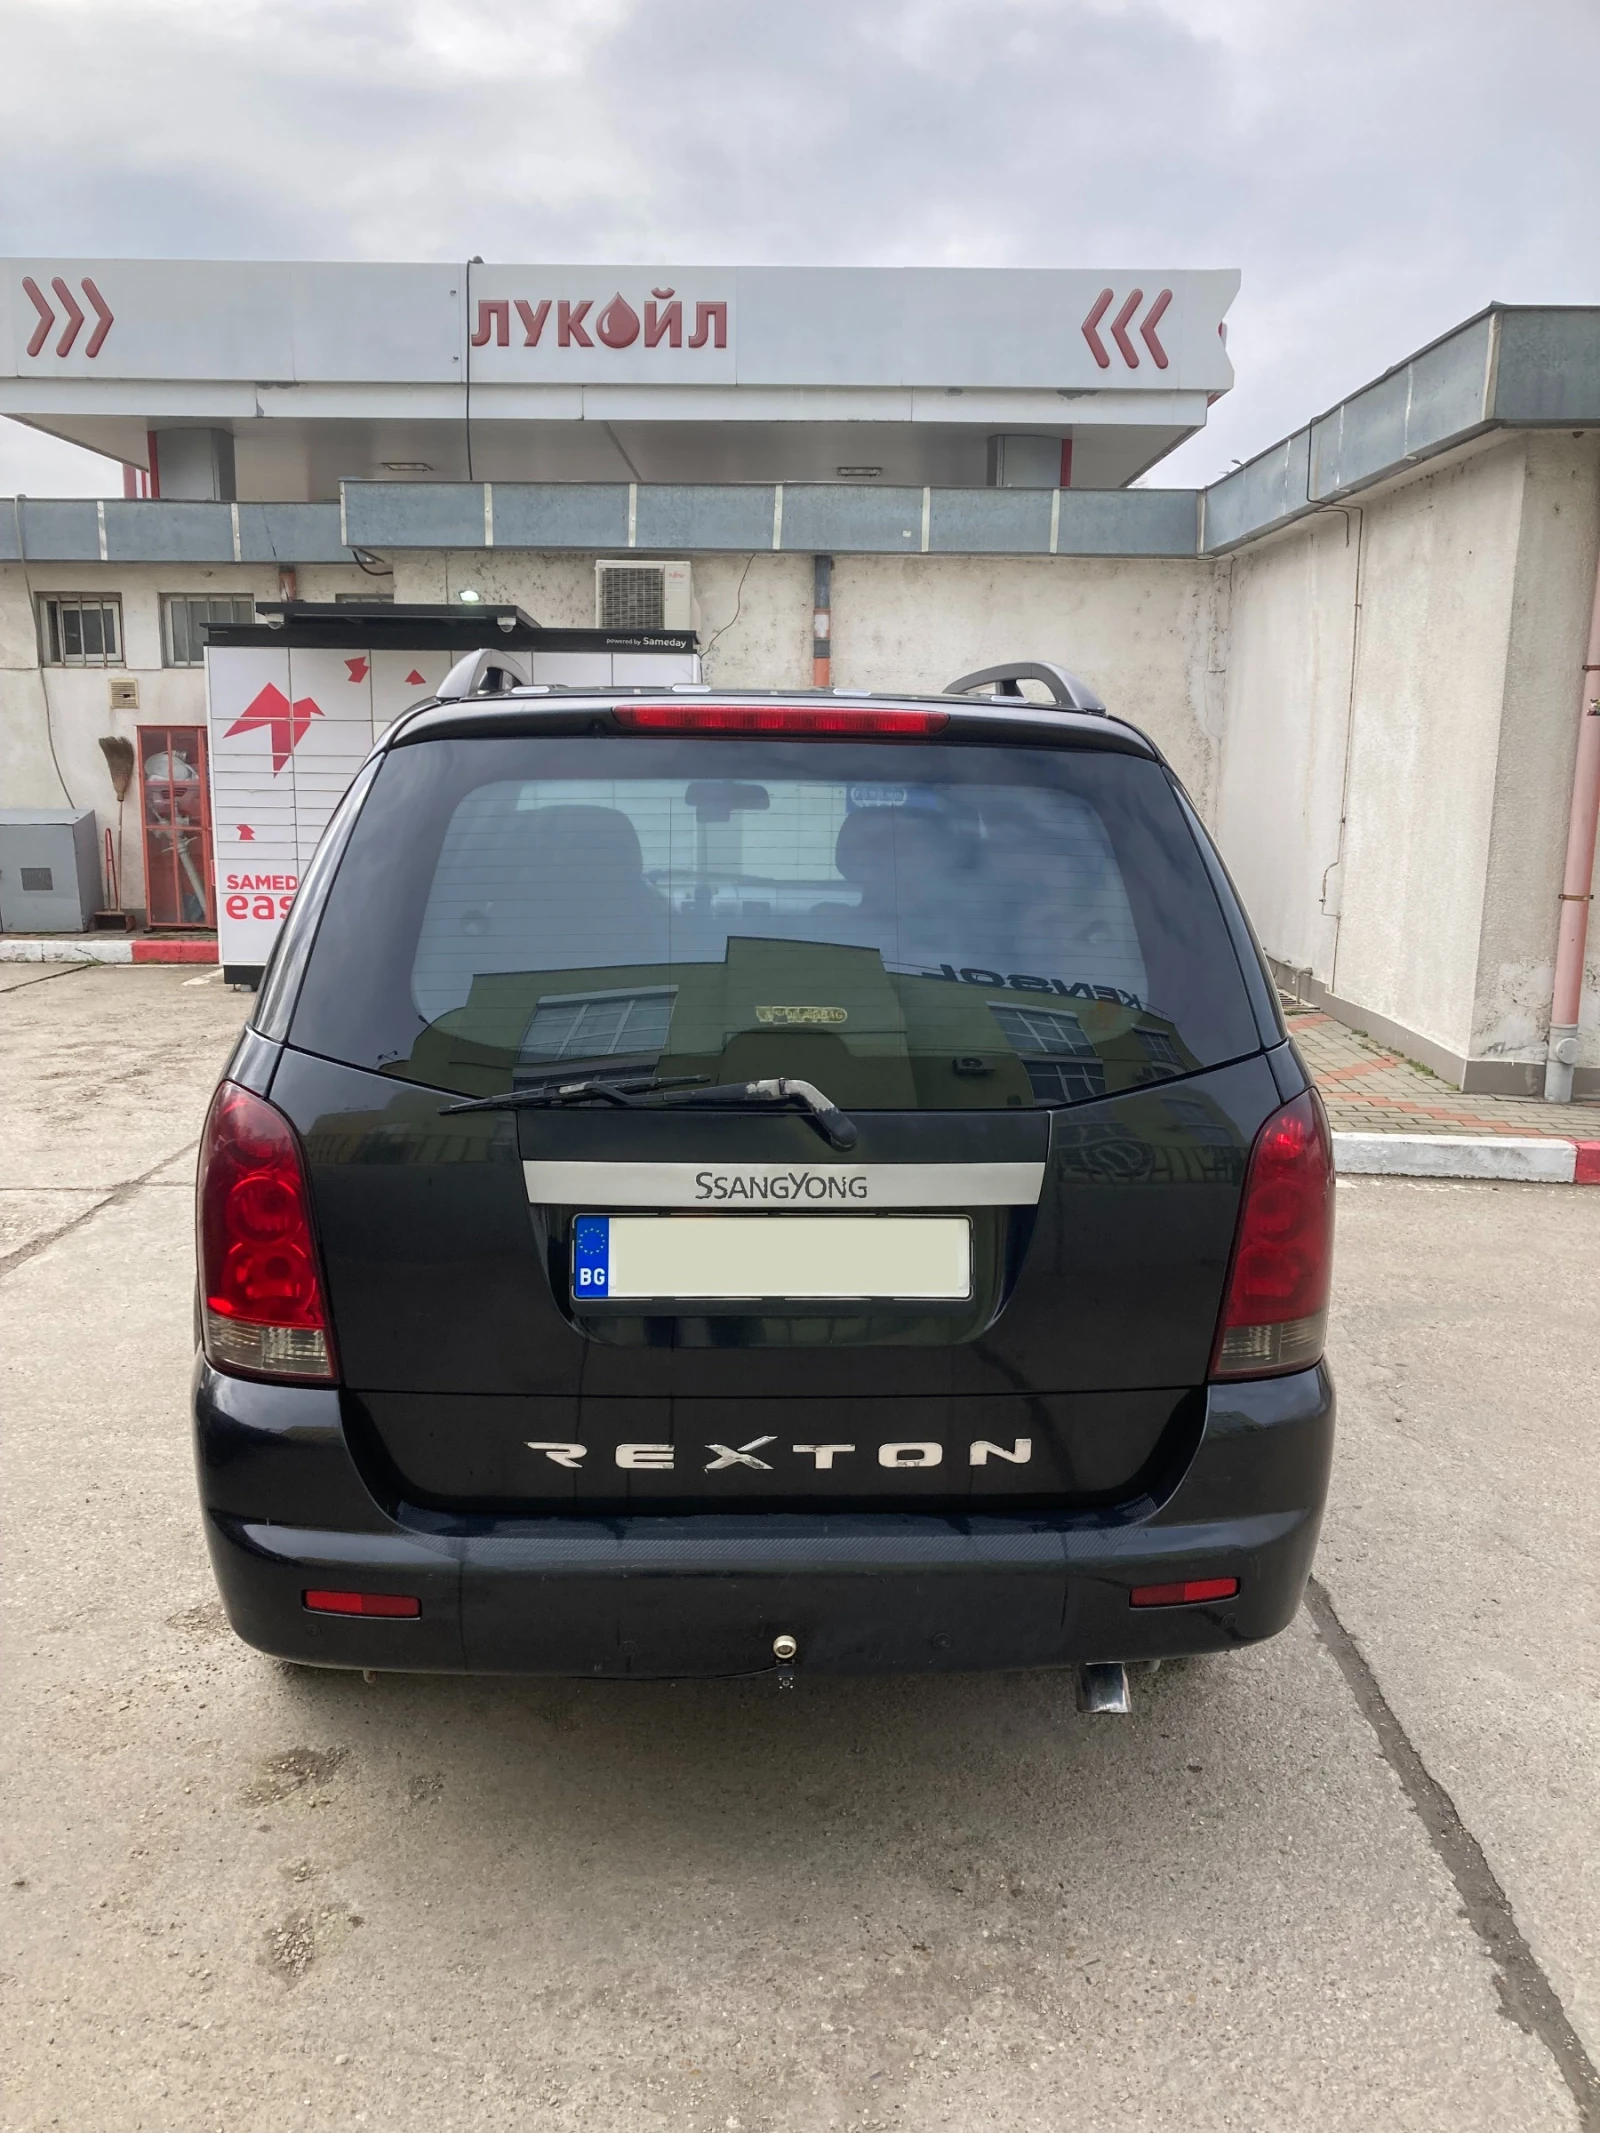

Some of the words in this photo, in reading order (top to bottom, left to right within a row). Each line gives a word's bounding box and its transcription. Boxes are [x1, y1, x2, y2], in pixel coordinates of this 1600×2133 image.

[471, 287, 727, 348] ЛУКОЙЛ
[634, 638, 641, 646] by
[643, 637, 687, 649] Sameday
[579, 1268, 606, 1286] BG
[523, 1436, 1032, 1472] REXTON
